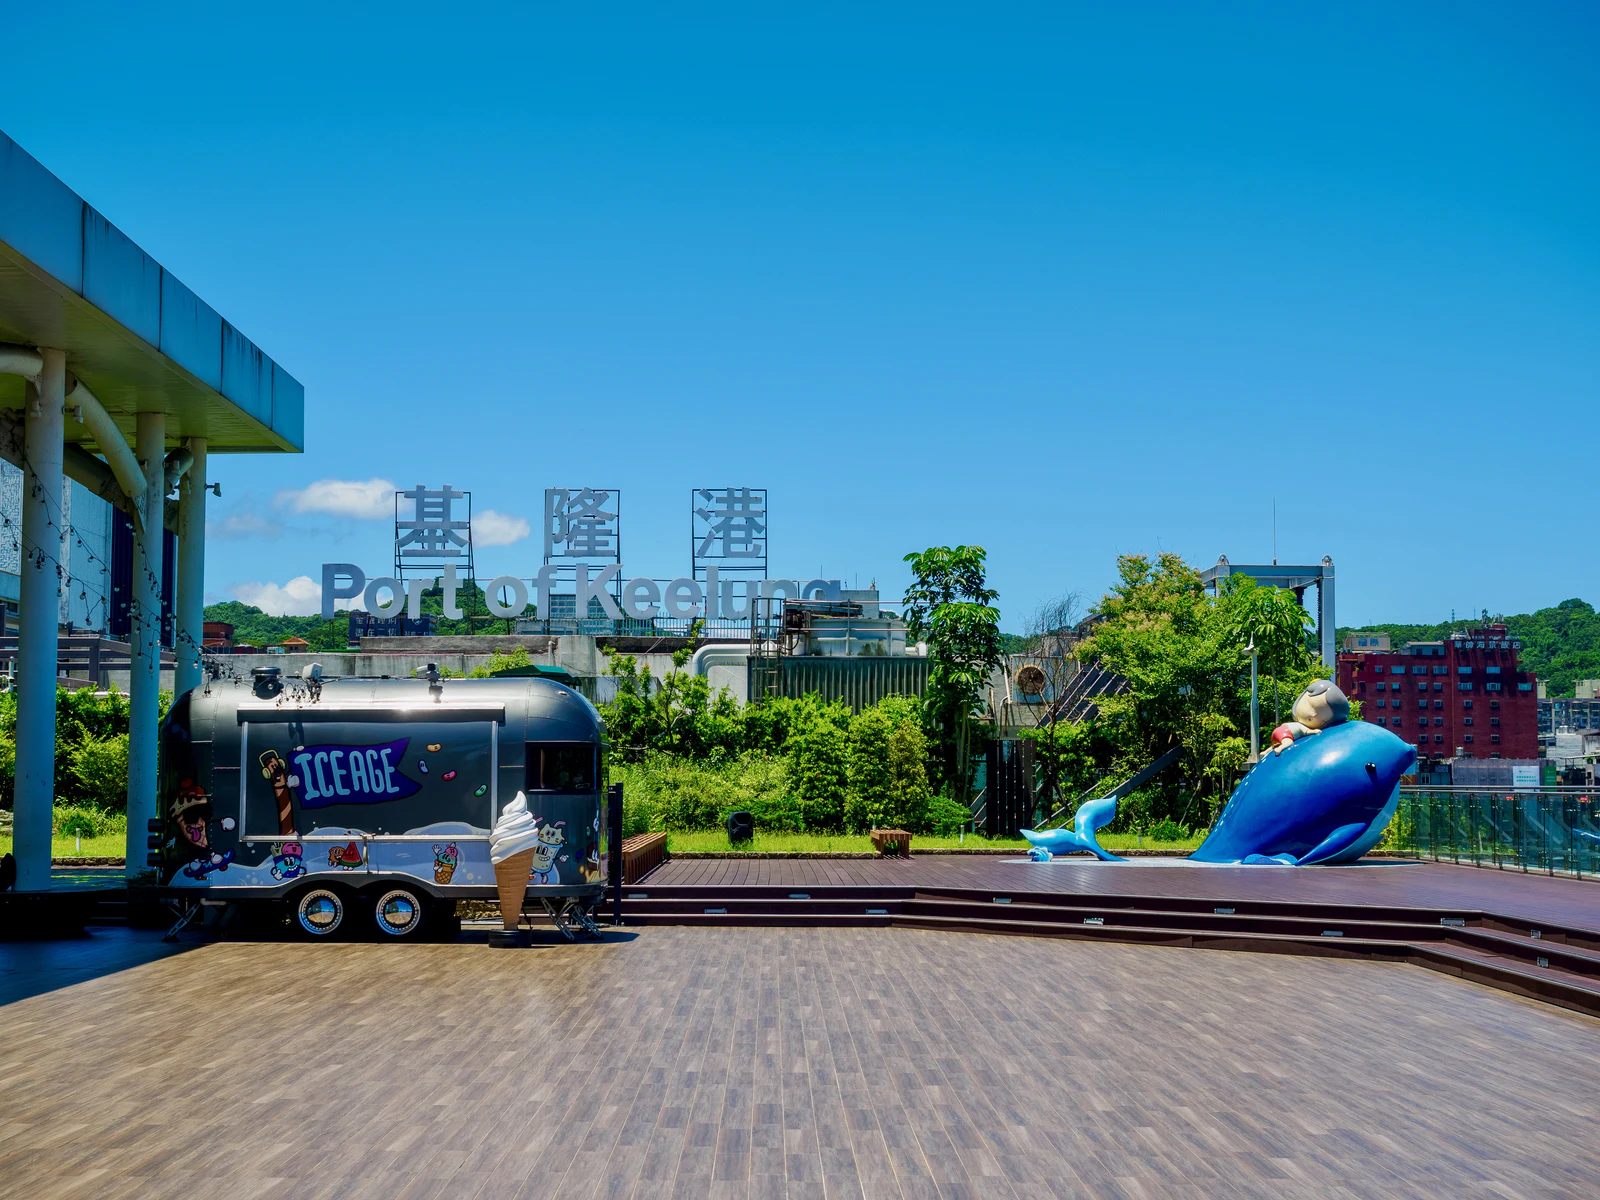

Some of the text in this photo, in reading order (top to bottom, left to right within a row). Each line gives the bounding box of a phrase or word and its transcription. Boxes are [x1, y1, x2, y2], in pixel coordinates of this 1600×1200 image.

[396, 484, 766, 559] 基隆港
[321, 563, 464, 620] Port
[485, 564, 557, 620] of
[294, 748, 400, 800] ICE AGE
